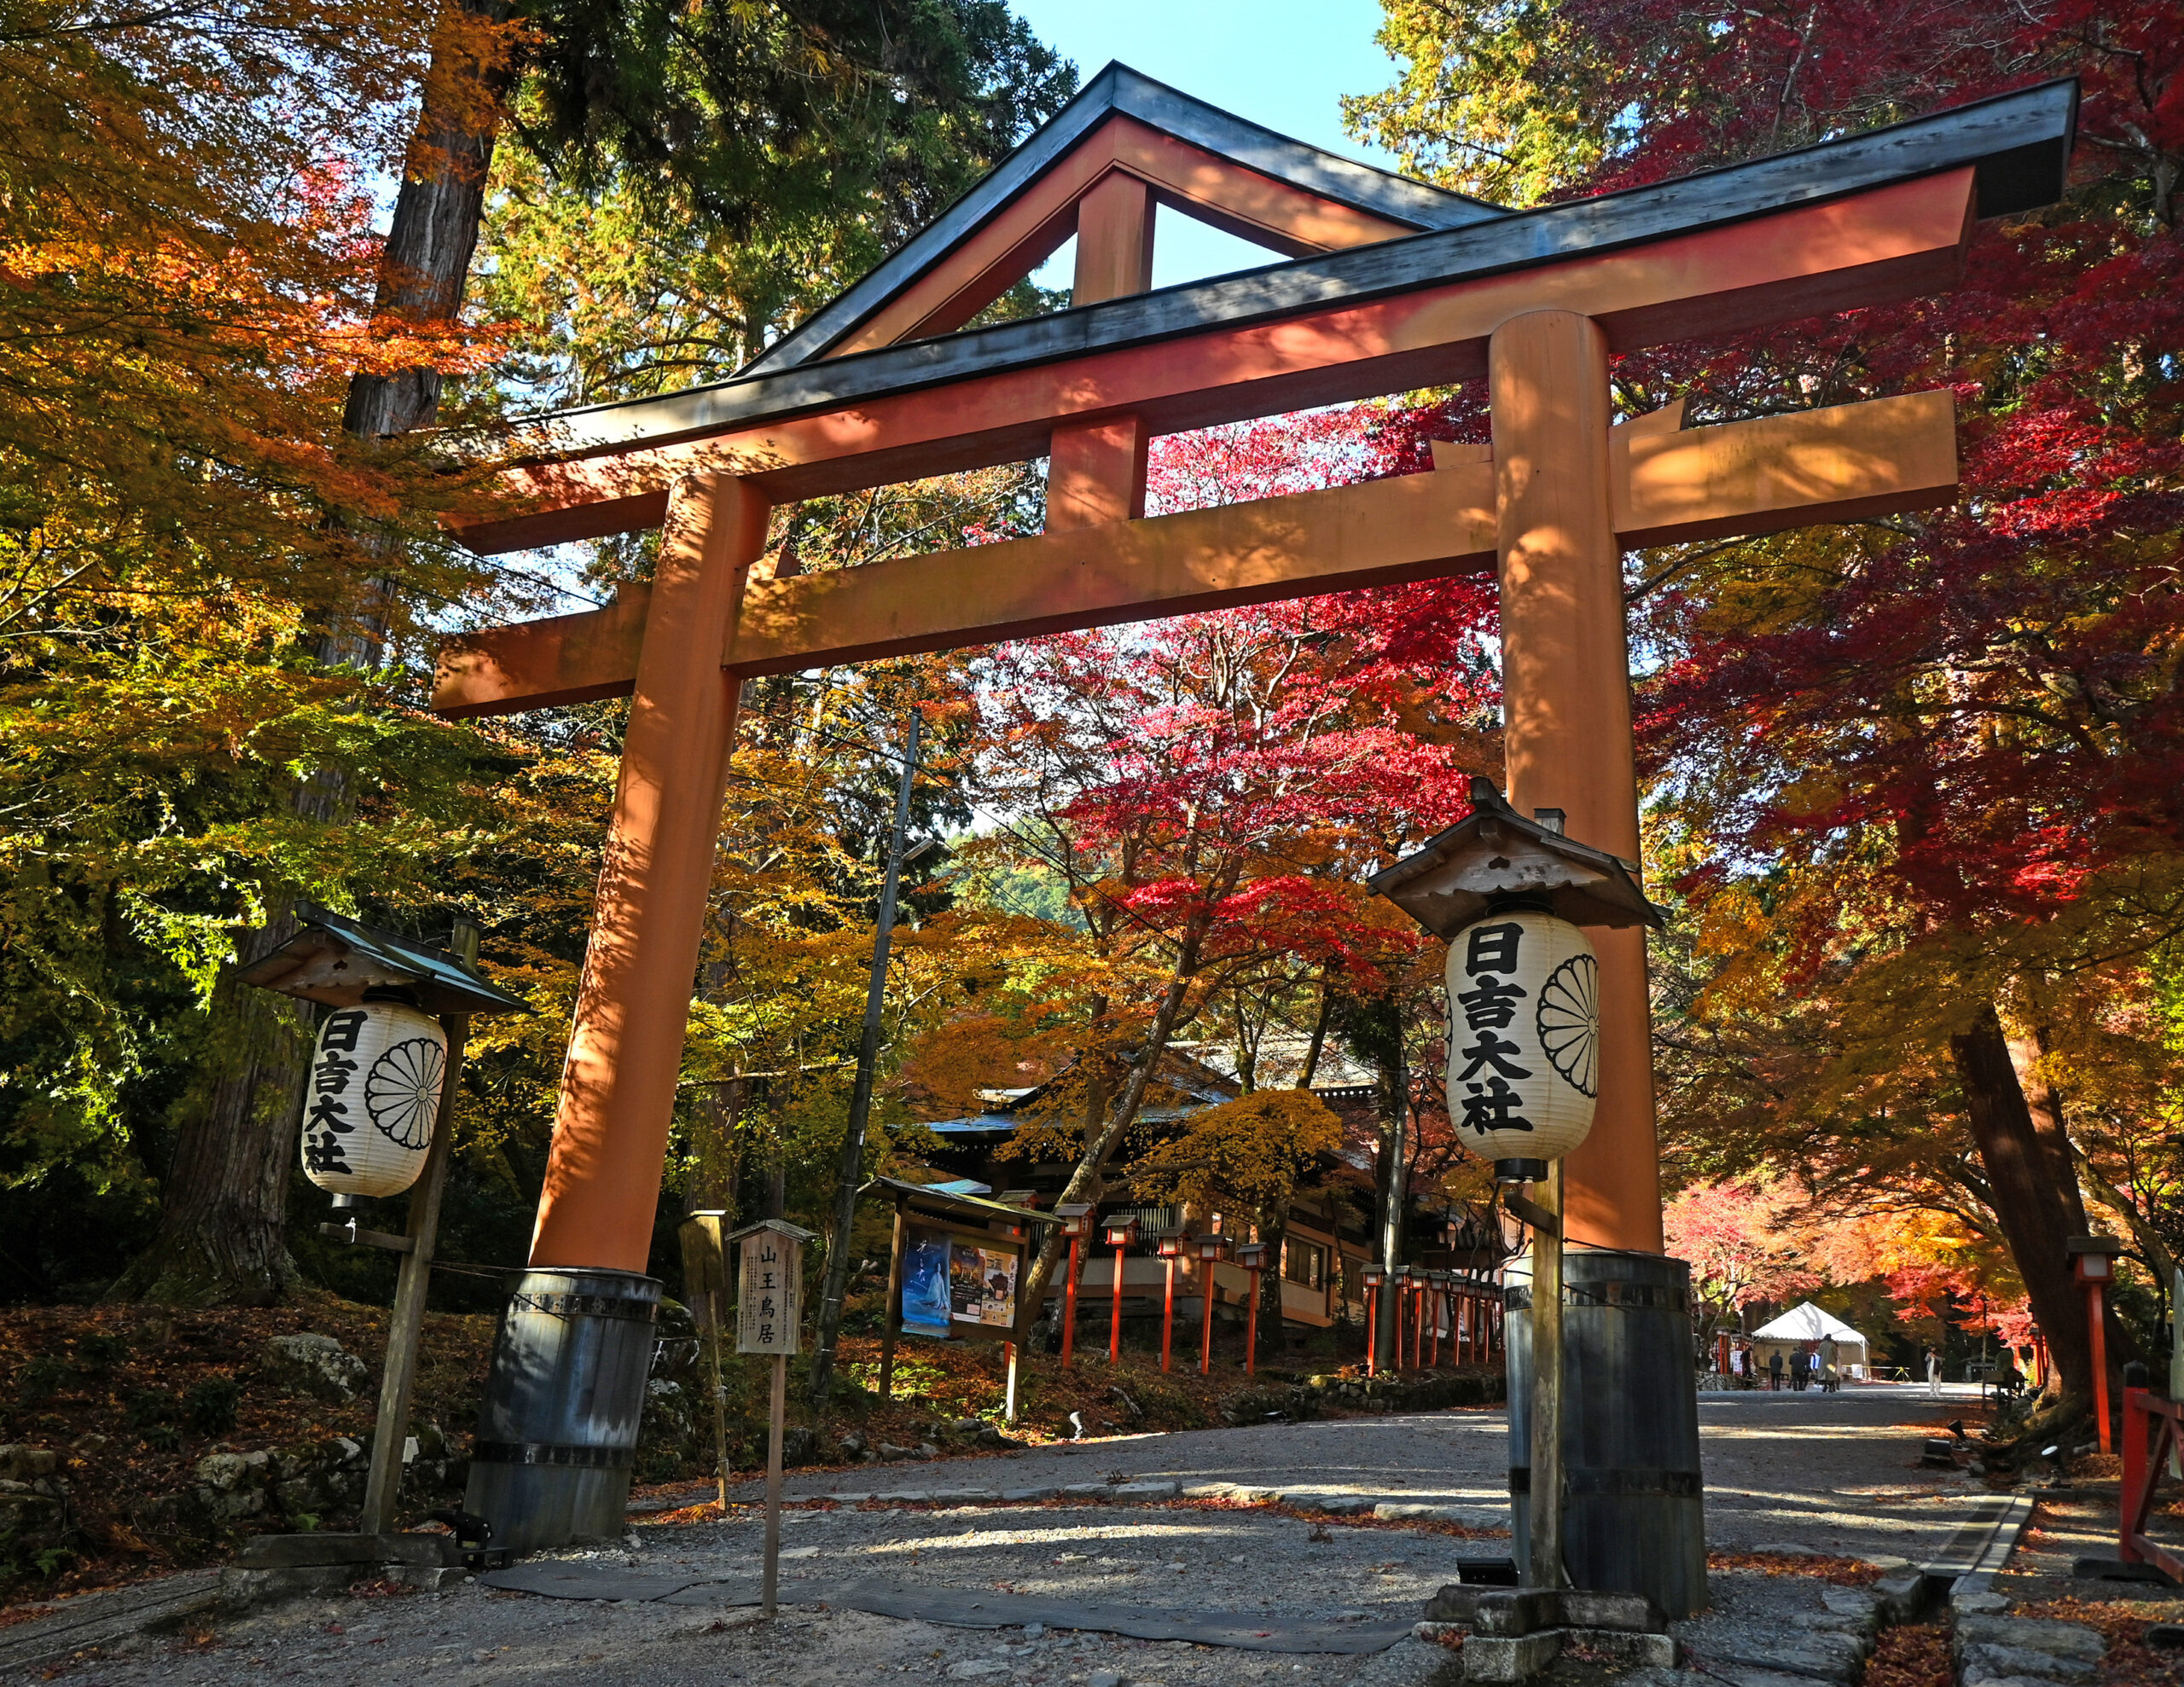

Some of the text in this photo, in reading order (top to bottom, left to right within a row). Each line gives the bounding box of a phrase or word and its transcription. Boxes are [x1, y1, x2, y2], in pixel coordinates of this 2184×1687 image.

[304, 1010, 369, 1175] 日吉大社
[1456, 922, 1533, 1136] 日吉大社
[757, 1246, 776, 1344] 山王鳥居
